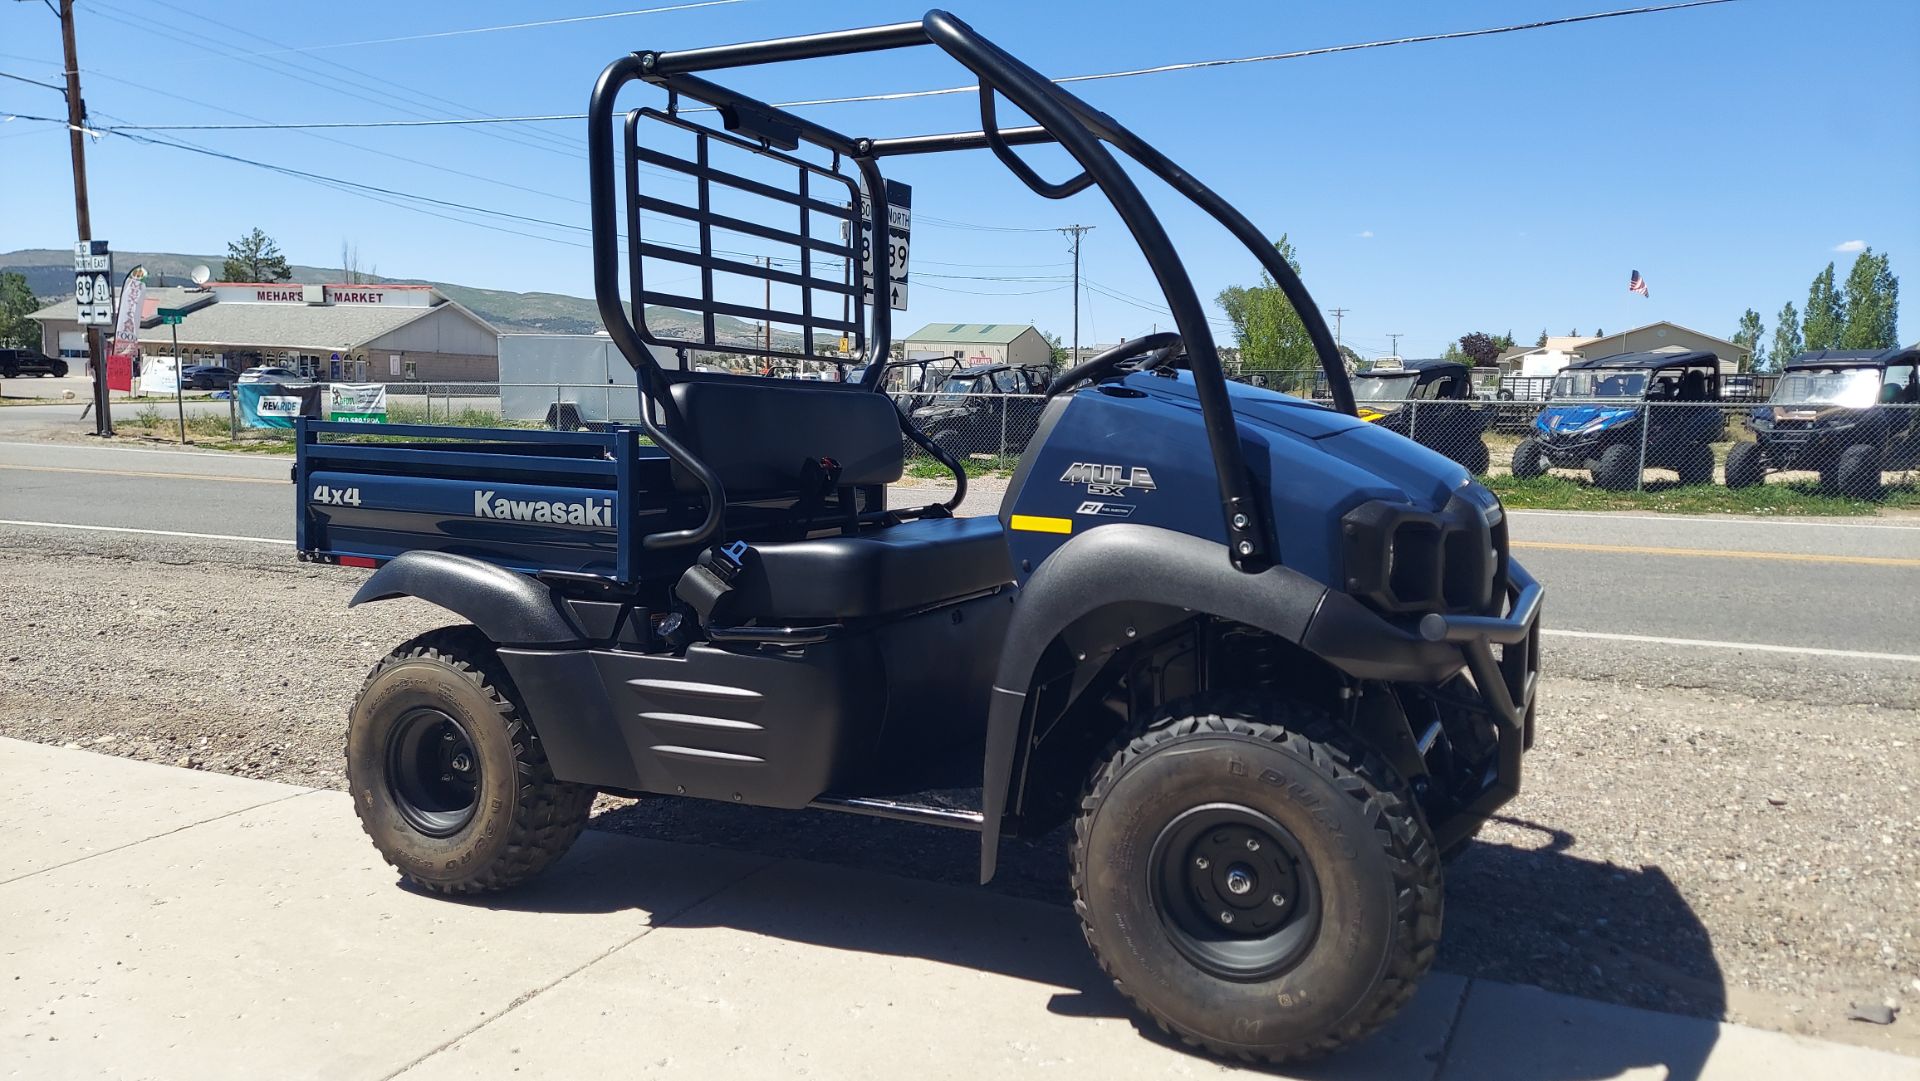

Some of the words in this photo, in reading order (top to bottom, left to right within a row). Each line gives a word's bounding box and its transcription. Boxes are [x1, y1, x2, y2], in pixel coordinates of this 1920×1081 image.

[888, 208, 910, 229] NORTH
[93, 258, 106, 269] EAST
[78, 281, 91, 297] 89
[97, 284, 105, 296] 31
[257, 291, 303, 302] MEHAR'S
[334, 292, 384, 303] MARKET
[1060, 462, 1157, 489] MULE
[313, 485, 362, 507] 4x4
[1087, 484, 1126, 497] SX
[474, 490, 612, 527] Kawasaki
[1081, 503, 1100, 512] FI
